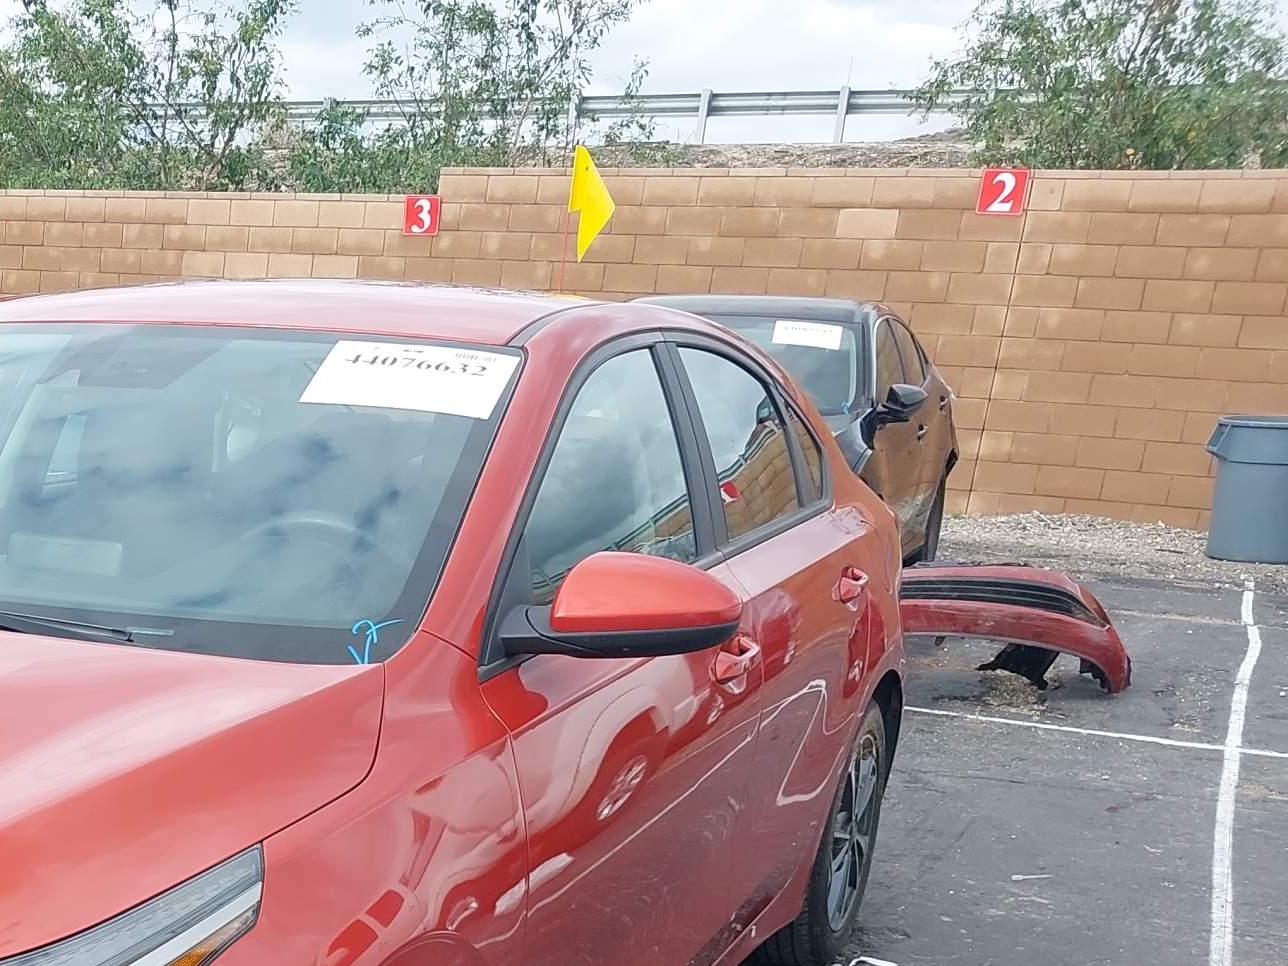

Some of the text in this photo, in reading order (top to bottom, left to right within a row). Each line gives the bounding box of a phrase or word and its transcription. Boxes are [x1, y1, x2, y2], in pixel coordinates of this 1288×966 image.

[985, 172, 1017, 213] 2
[410, 198, 432, 233] 3
[344, 353, 488, 377] 44076632
